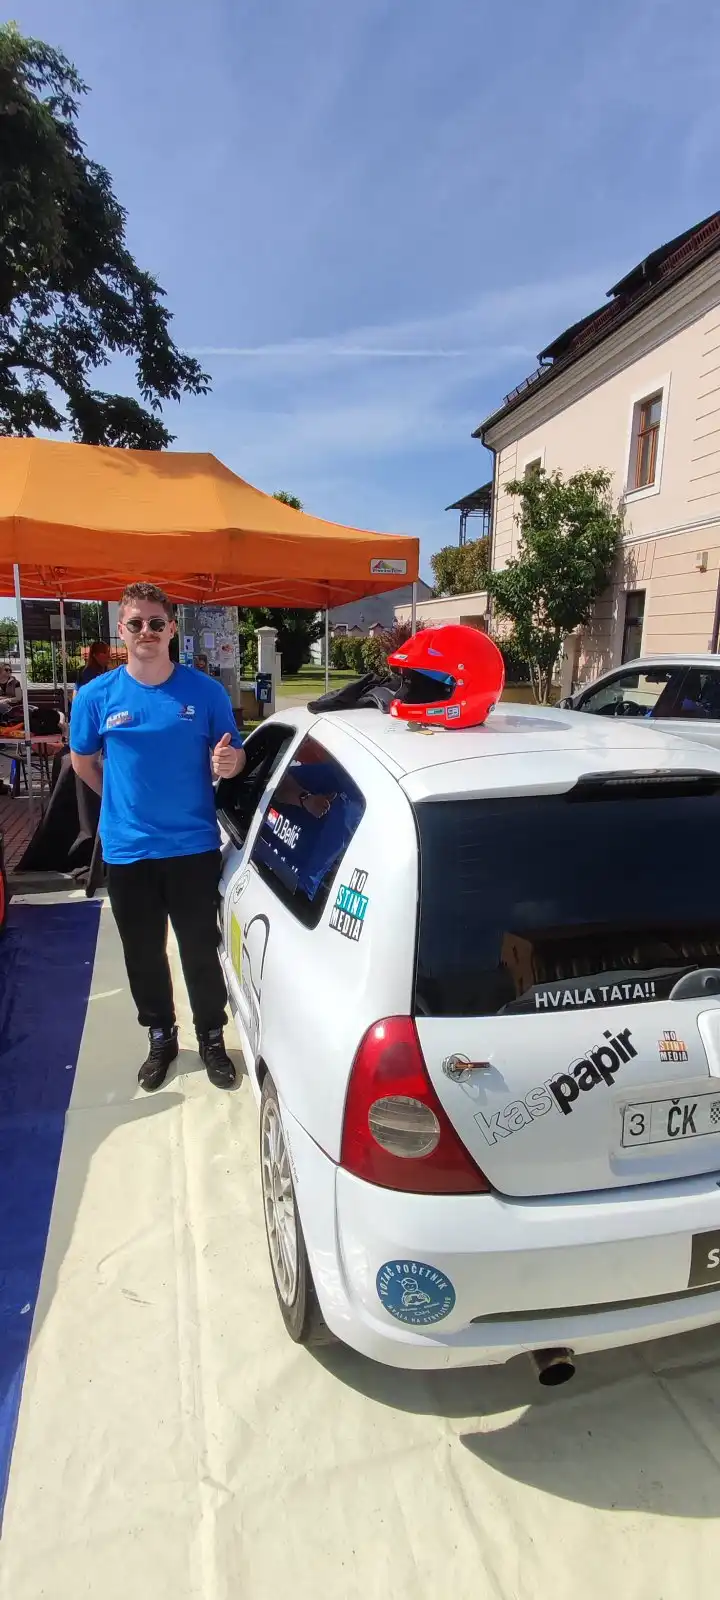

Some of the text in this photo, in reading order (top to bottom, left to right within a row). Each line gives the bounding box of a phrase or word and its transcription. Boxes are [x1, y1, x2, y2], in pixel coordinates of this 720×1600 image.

[350, 870, 366, 891] NO
[336, 886, 367, 918] STINT
[330, 906, 361, 939] MEDIA
[534, 981, 656, 1009] HVALA TATA!!
[664, 1031, 676, 1041] NO
[660, 1051, 688, 1062] MEDIA
[629, 1100, 697, 1136] 3 ČK
[396, 1263, 448, 1290] POČETNIK
